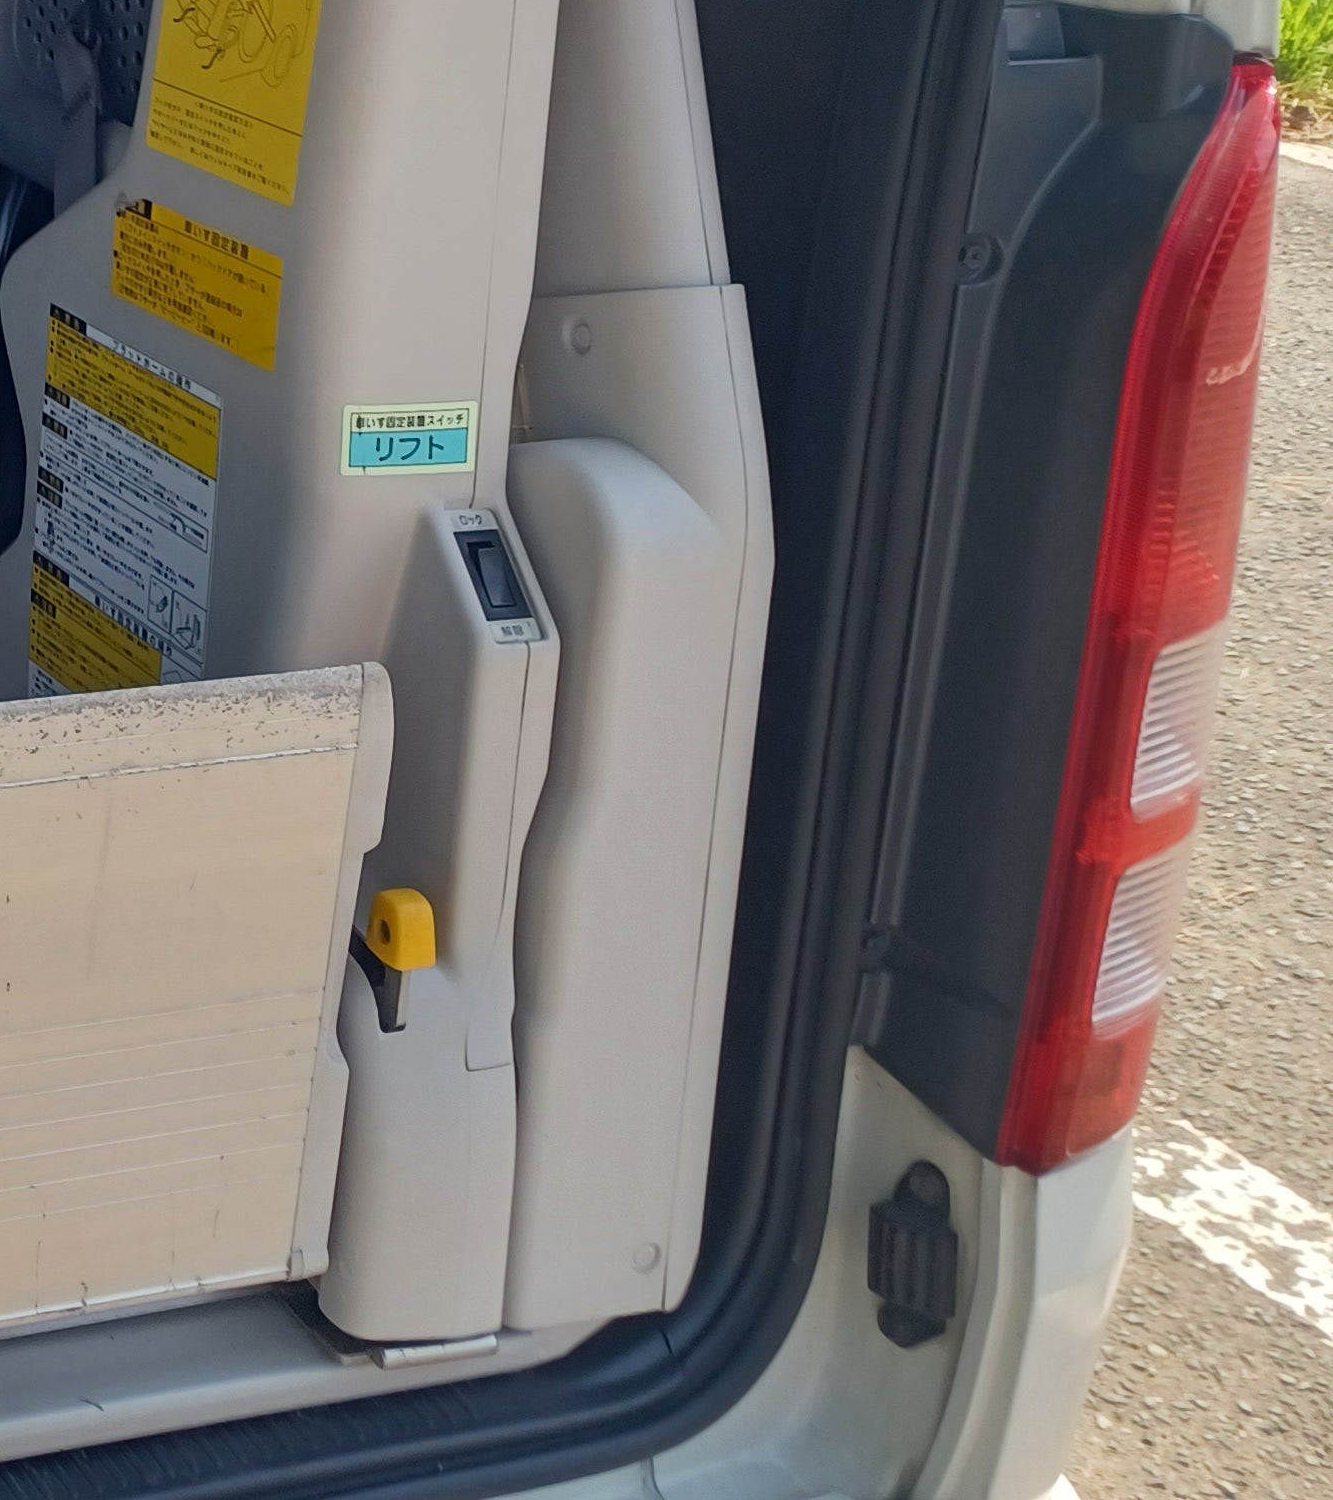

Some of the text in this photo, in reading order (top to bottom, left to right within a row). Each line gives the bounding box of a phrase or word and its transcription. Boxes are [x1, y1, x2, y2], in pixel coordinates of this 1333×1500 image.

[355, 413, 465, 429] 車いす固定装置スイッチ
[375, 435, 445, 462] リフト
[459, 514, 483, 526] ロック
